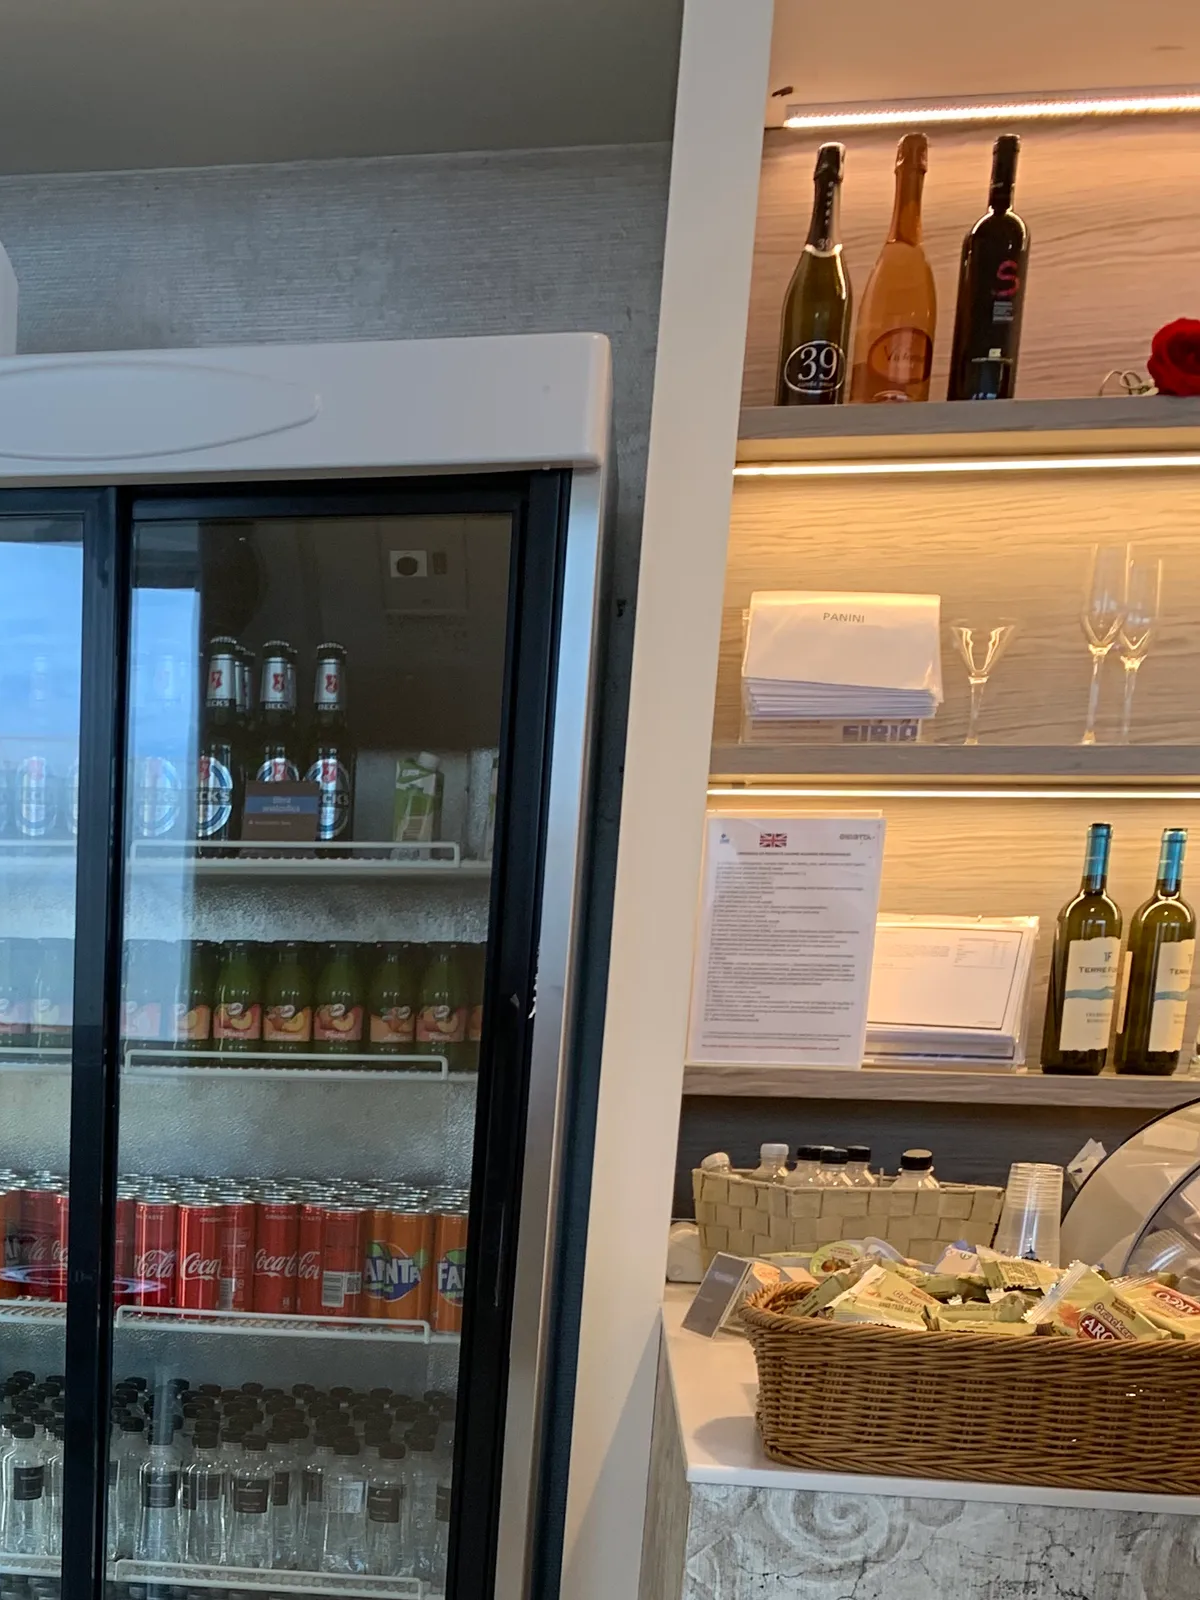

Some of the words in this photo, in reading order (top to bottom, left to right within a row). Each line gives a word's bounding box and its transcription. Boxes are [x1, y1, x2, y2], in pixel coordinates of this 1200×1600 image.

[798, 346, 838, 381] 39
[822, 612, 865, 623] PANINI
[437, 1262, 466, 1291] FA
